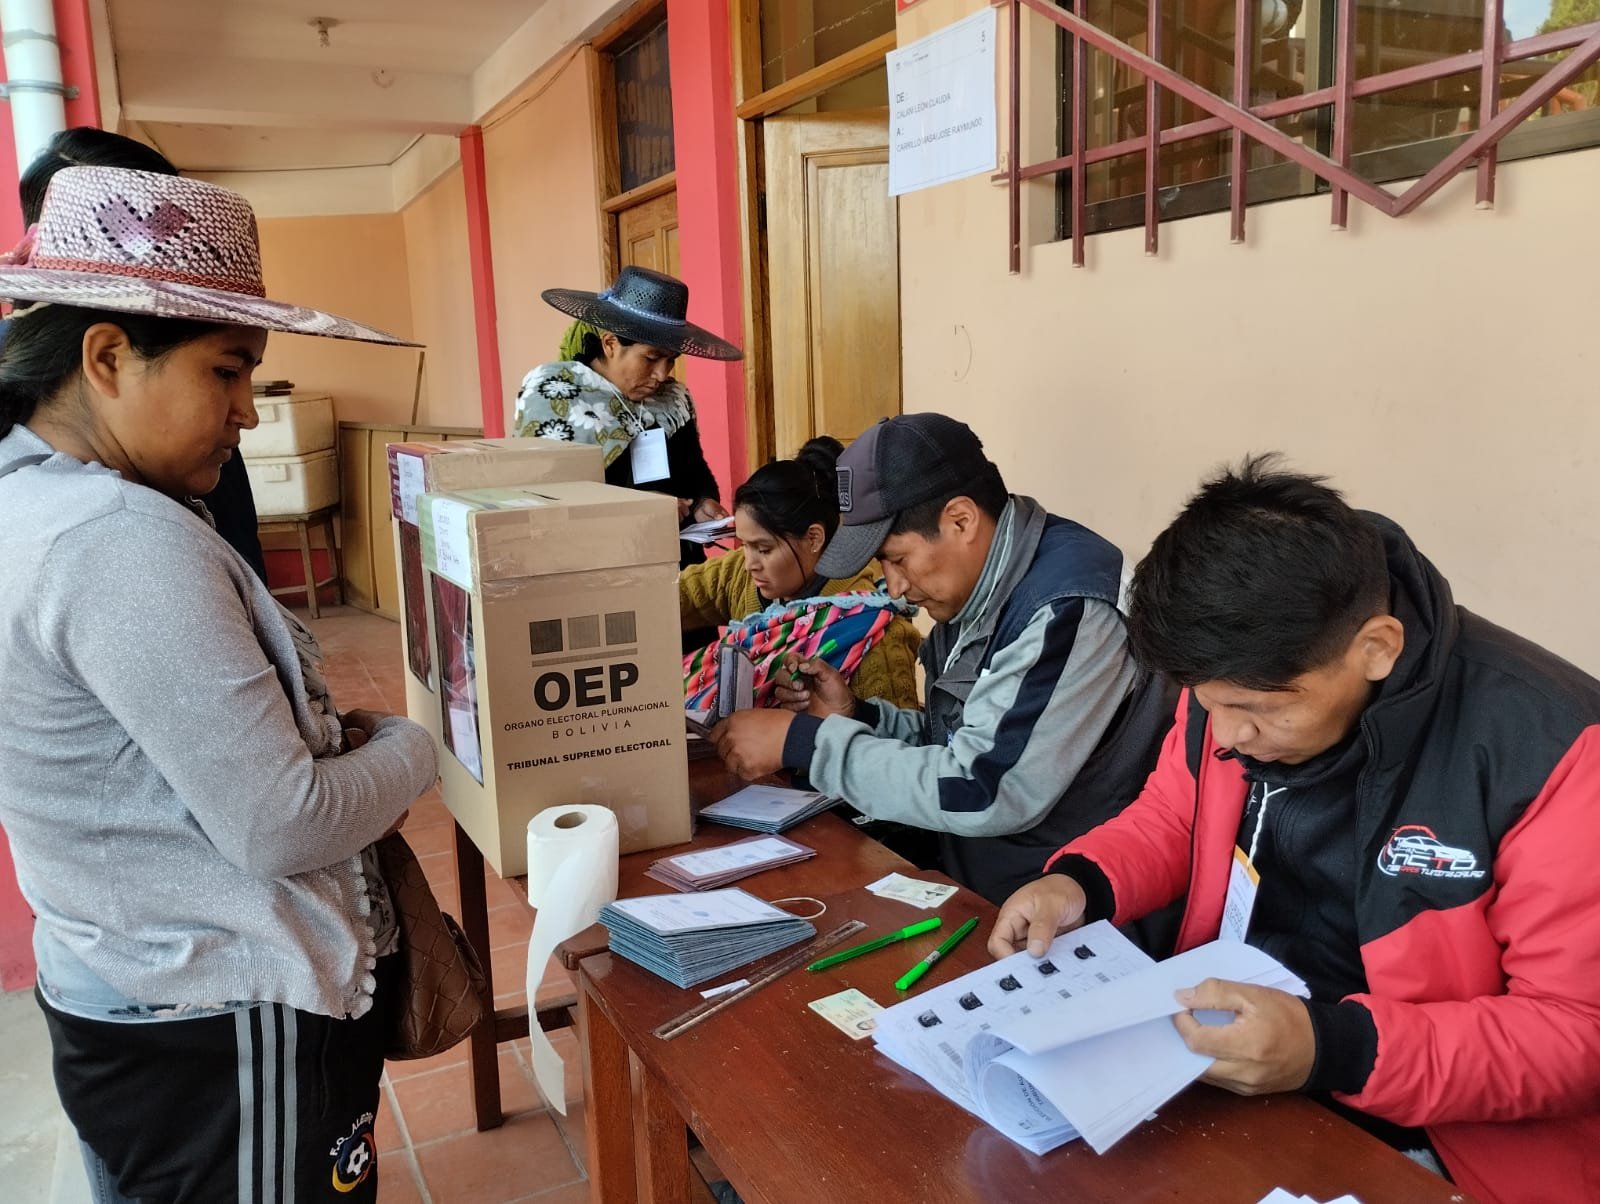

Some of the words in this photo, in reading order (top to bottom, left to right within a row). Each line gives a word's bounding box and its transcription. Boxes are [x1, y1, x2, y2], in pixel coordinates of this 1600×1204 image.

[928, 92, 951, 111] CLAUDIA
[951, 116, 983, 137] RAYMUNDO
[534, 662, 639, 711] OEP
[546, 711, 600, 726] ELECTORAL
[601, 700, 670, 717] PLURINACIONAL
[552, 719, 632, 740] BOLIVIA
[507, 755, 560, 771] TRIBUNAL
[562, 747, 612, 763] SUPREMO
[614, 738, 672, 754] ELECTORAL
